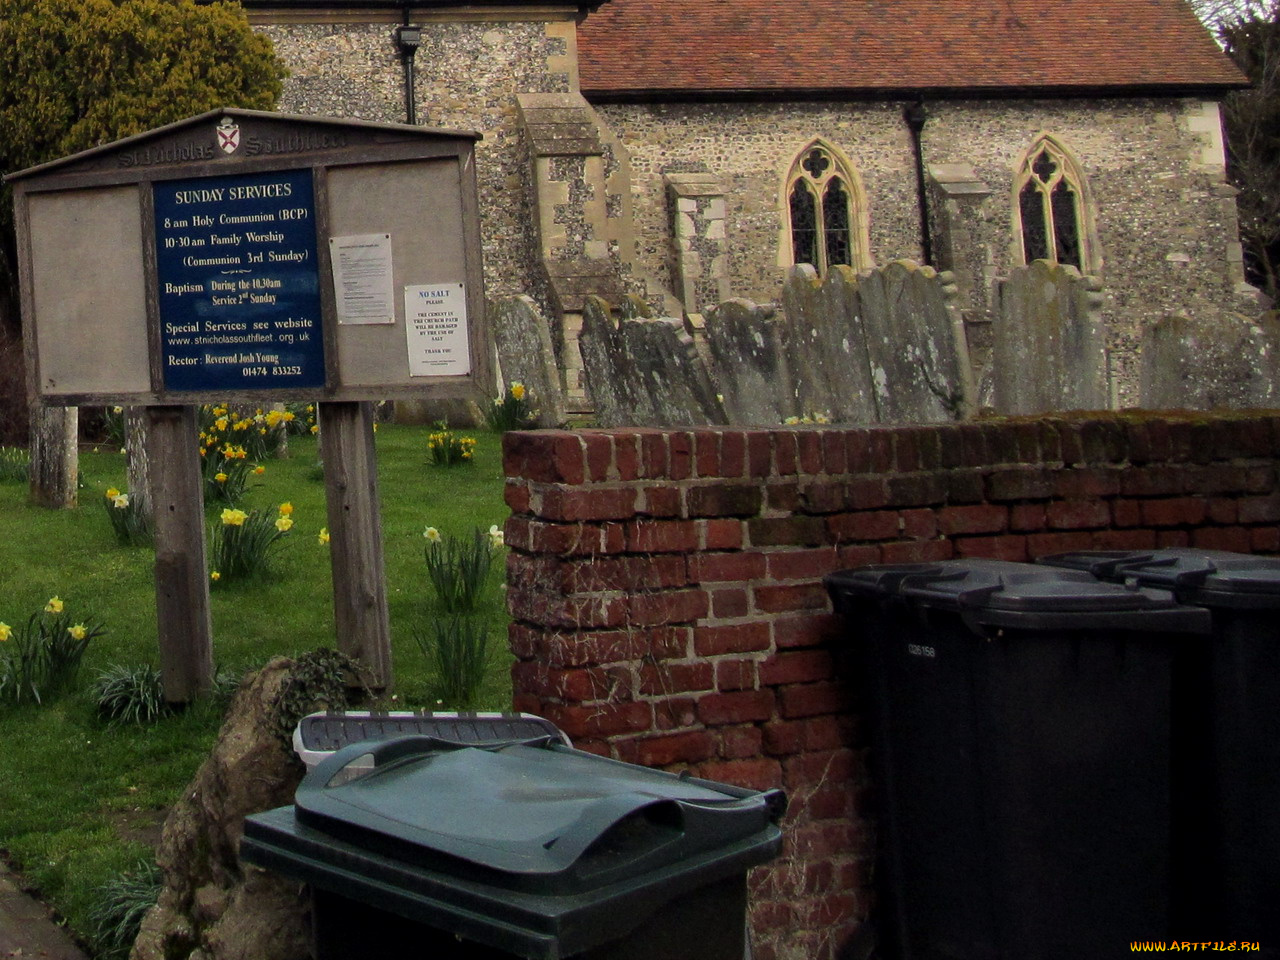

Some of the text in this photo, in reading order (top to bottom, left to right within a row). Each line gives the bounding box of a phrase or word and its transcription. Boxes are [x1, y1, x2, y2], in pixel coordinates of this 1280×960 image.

[175, 183, 292, 204] SUNDAY SERVICES
[192, 216, 215, 227] Holy
[220, 212, 275, 225] Communion
[278, 208, 308, 221] (BCP)
[210, 234, 242, 246] Family
[245, 231, 284, 243] Worship
[183, 249, 309, 267] (Communion 3rd Sunday)
[165, 278, 282, 296] Baptism During the 10.30am
[431, 290, 450, 298] SALT
[212, 295, 237, 306] Service
[250, 293, 277, 305] Sunday
[165, 322, 199, 335] Special
[205, 320, 247, 332] Services
[274, 317, 313, 328] website
[205, 353, 238, 364] Reverend
[238, 353, 255, 363] Josh
[255, 352, 279, 364] Young
[242, 366, 302, 376] 01474 833252
